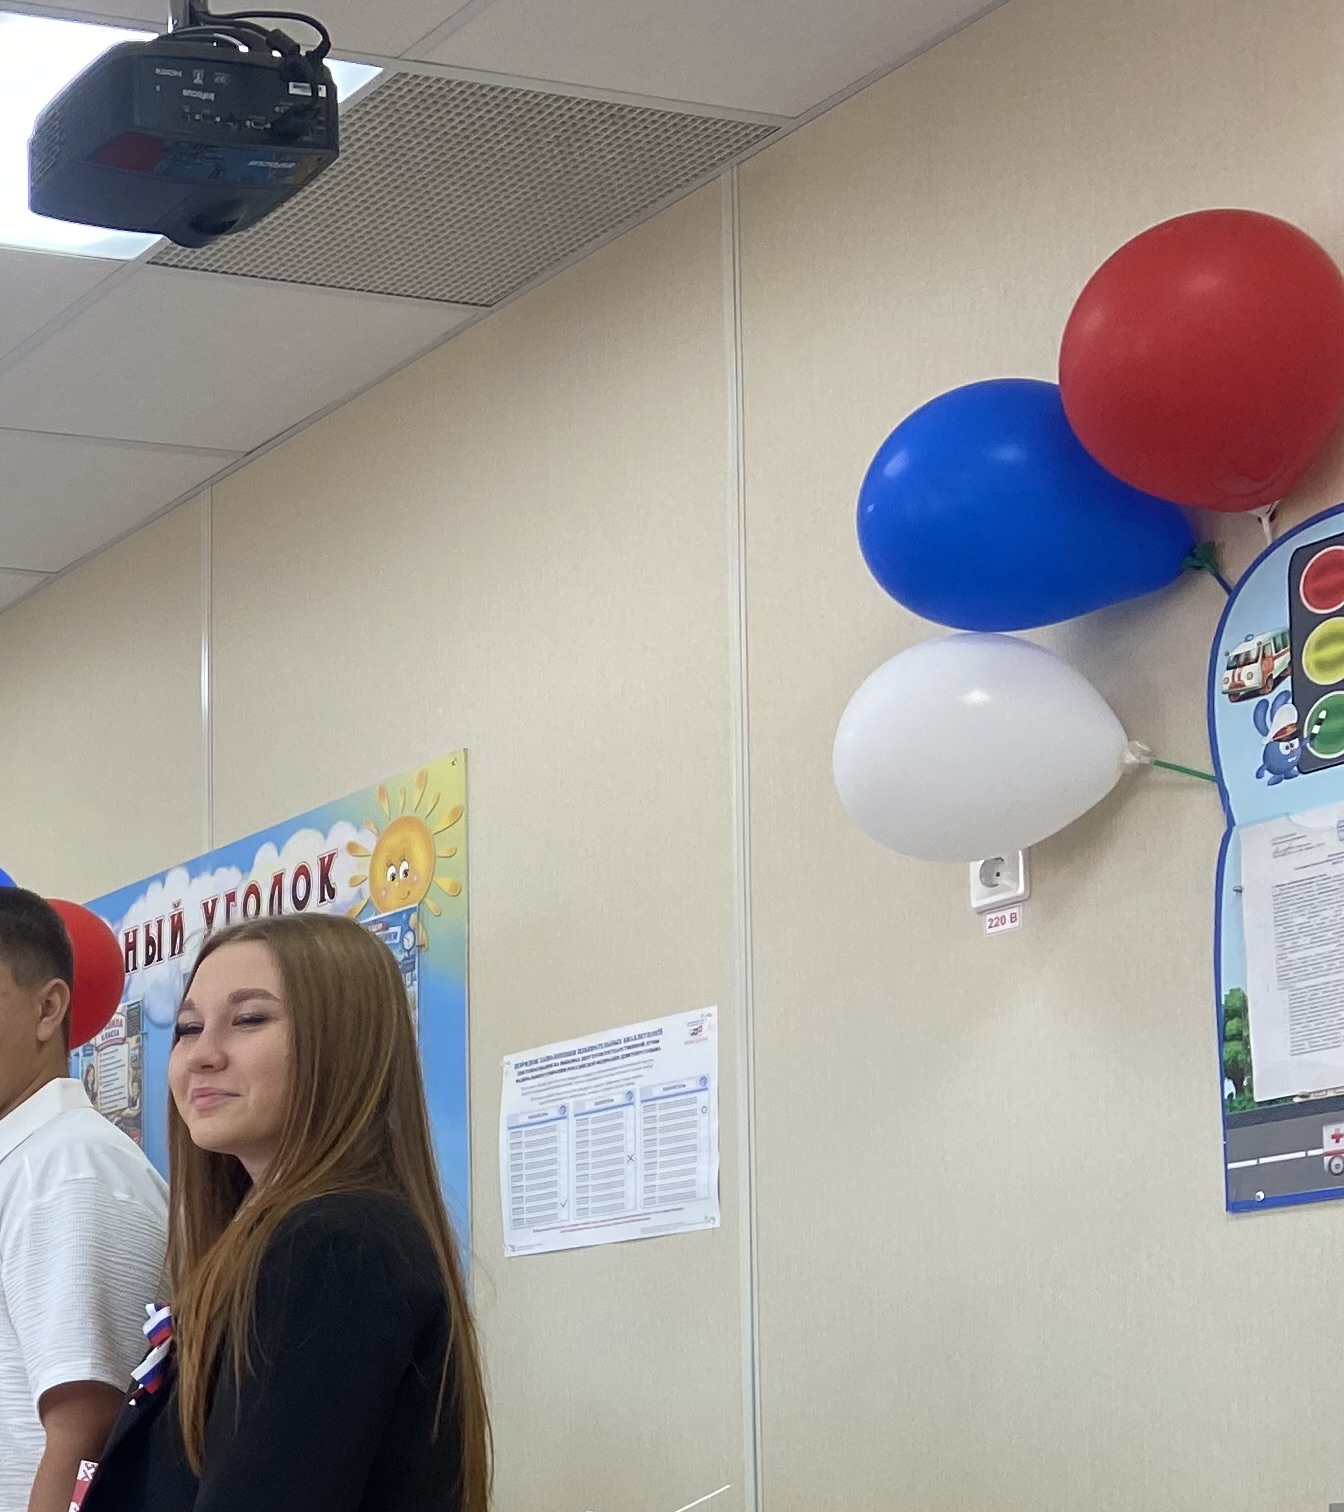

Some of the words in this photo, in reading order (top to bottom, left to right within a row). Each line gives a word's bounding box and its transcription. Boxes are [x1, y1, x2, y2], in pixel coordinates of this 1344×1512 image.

[123, 900, 185, 973] НЫЙ
[201, 848, 338, 936] УГОЛОК
[988, 915, 1006, 929] 220
[1010, 912, 1017, 923] В
